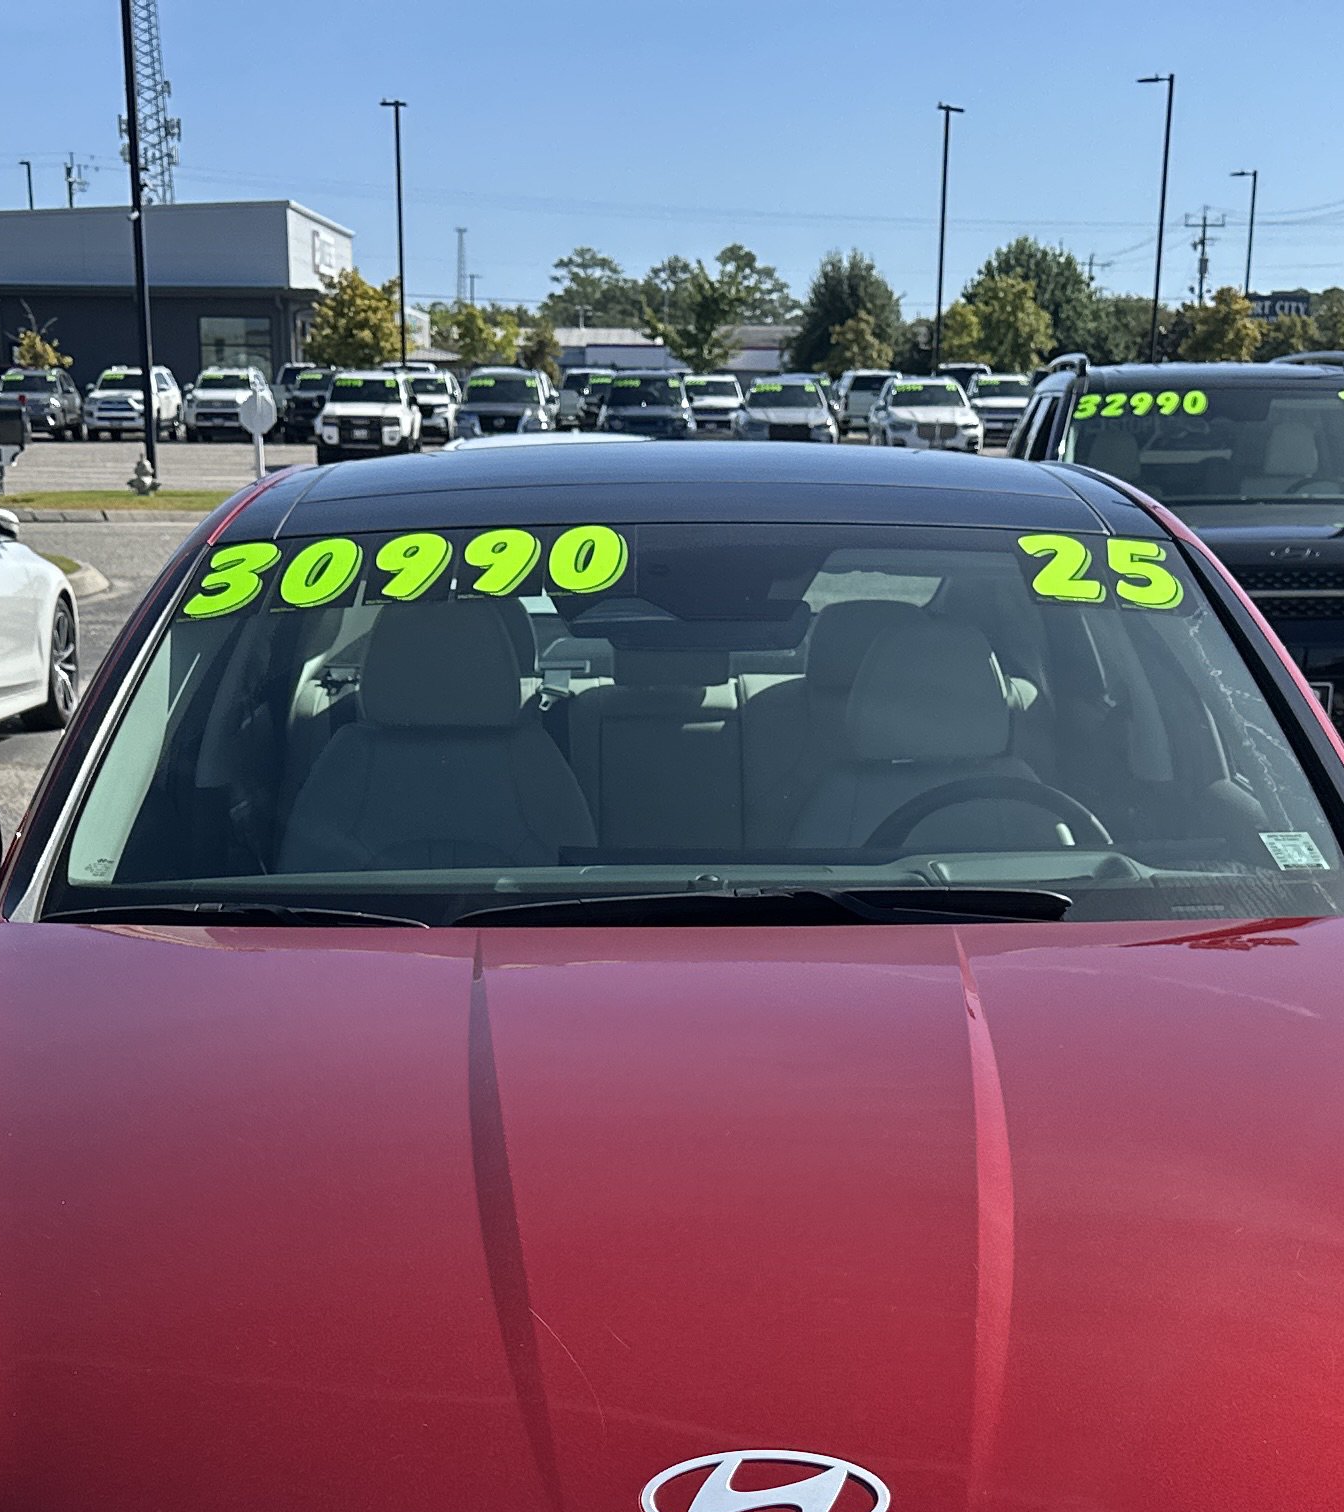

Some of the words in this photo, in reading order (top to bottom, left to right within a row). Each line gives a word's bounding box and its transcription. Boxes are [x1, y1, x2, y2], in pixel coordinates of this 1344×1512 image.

[1275, 300, 1307, 317] CITY
[1073, 390, 1208, 420] 32990
[182, 524, 629, 619] 30990
[1017, 534, 1185, 610] 25
